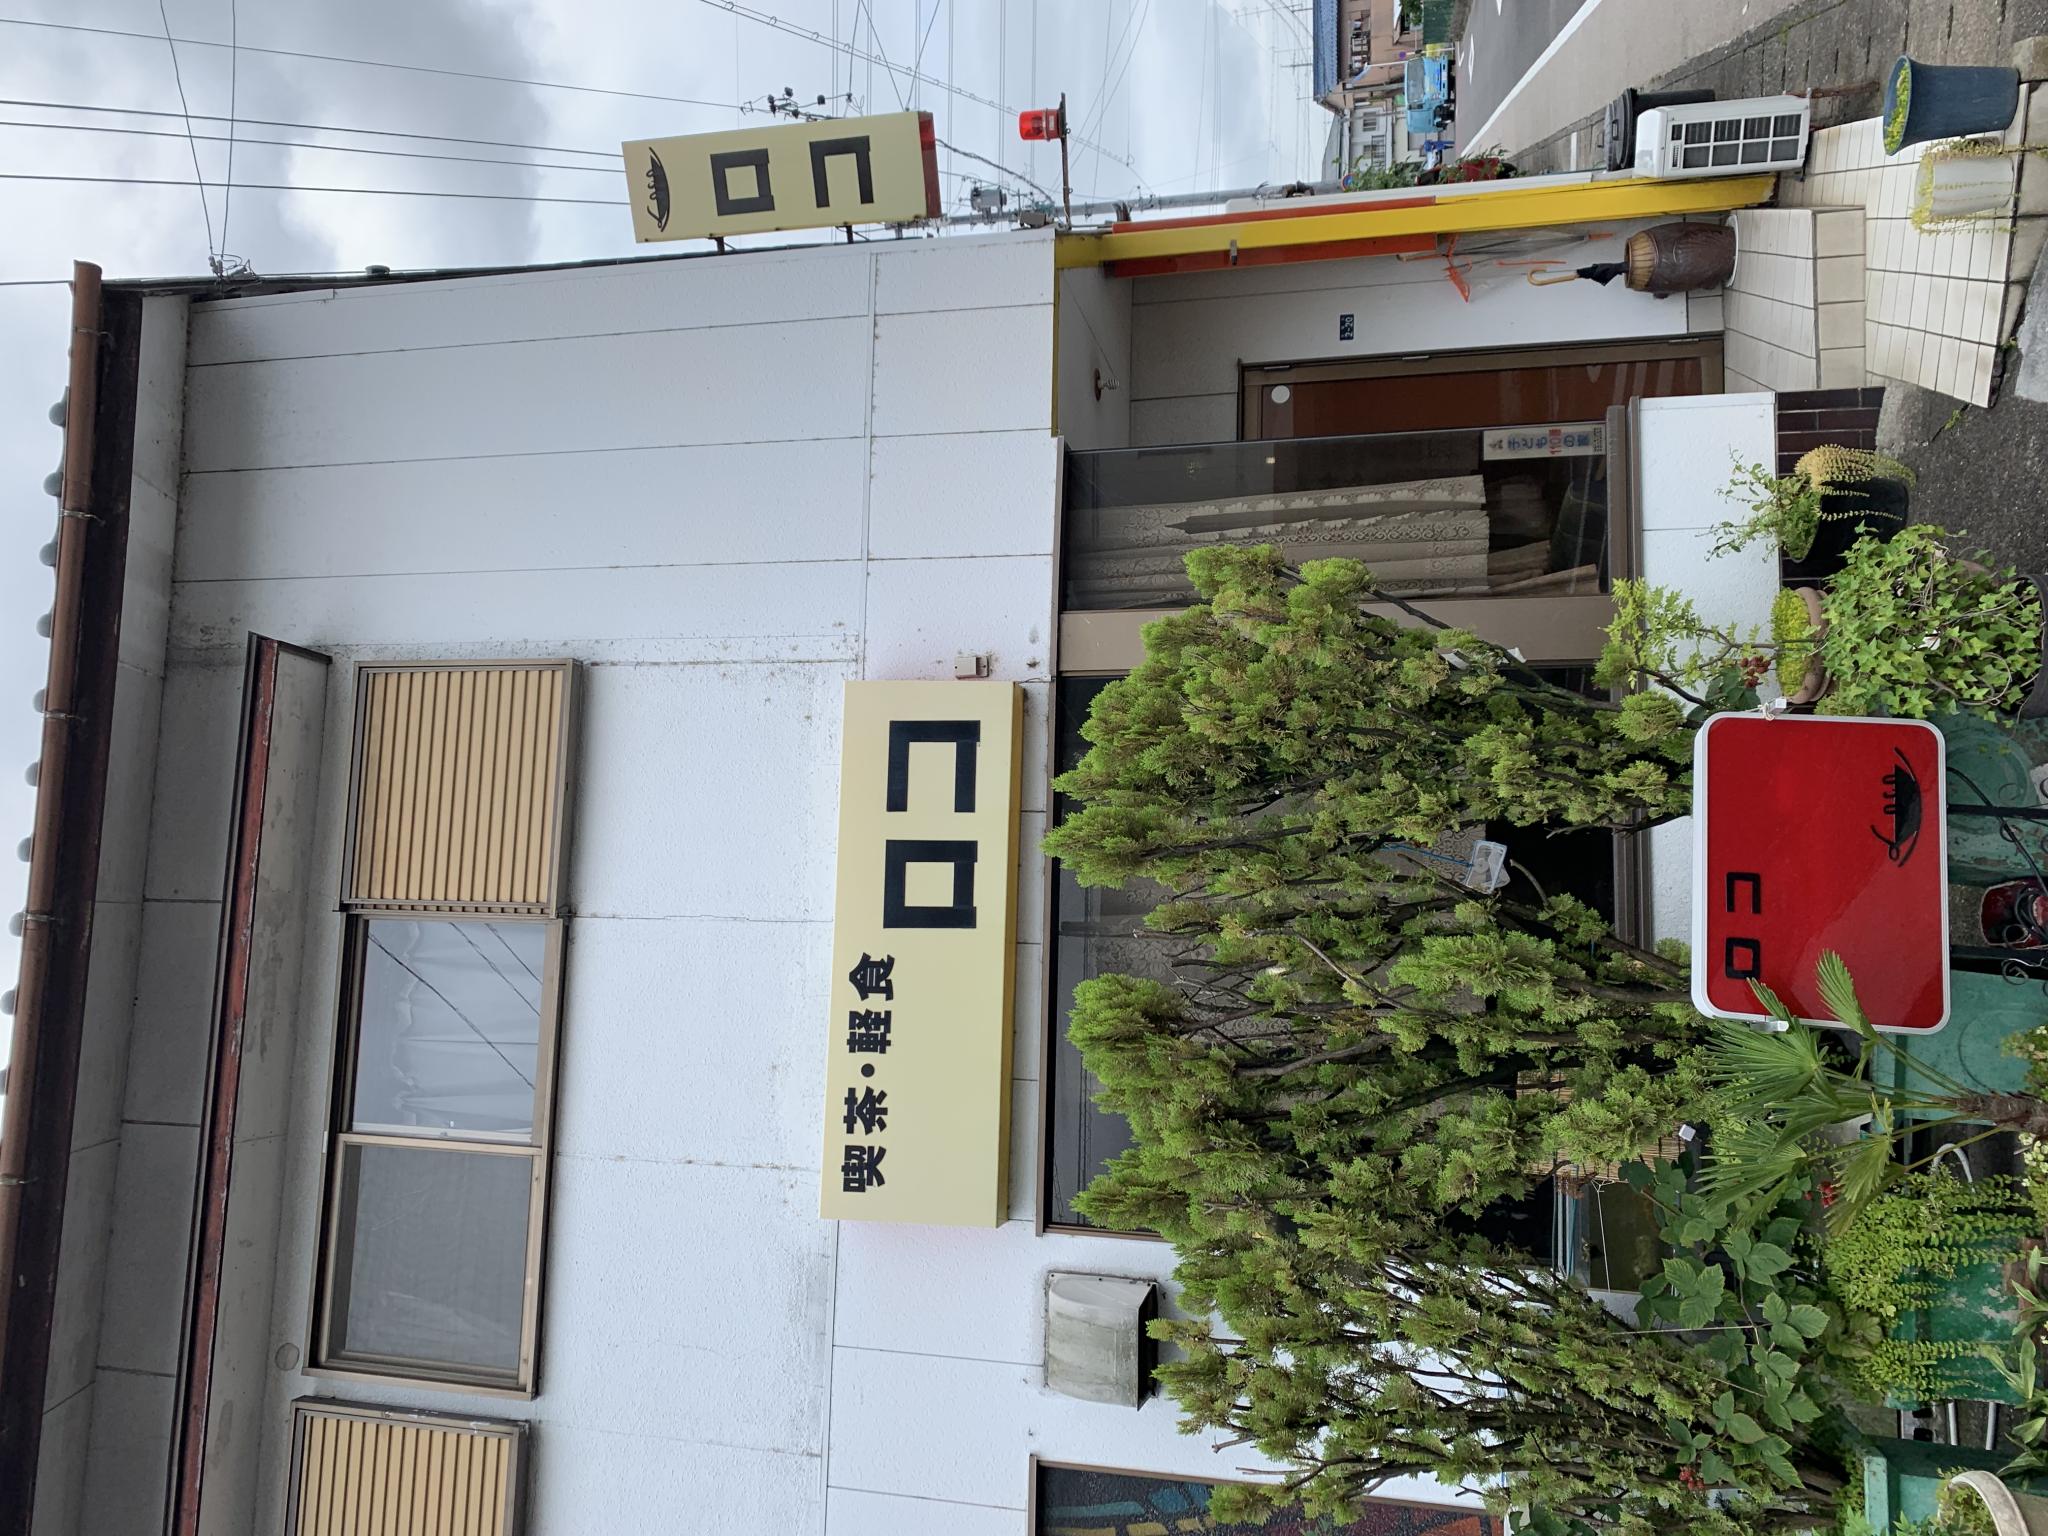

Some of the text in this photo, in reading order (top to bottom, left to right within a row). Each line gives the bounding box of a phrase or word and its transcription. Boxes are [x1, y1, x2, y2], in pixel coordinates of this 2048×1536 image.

[710, 136, 874, 216] ロコ
[883, 719, 981, 929] ロコ
[1725, 871, 1761, 980] ロコ
[840, 952, 895, 1193] 喫茶・軽食
